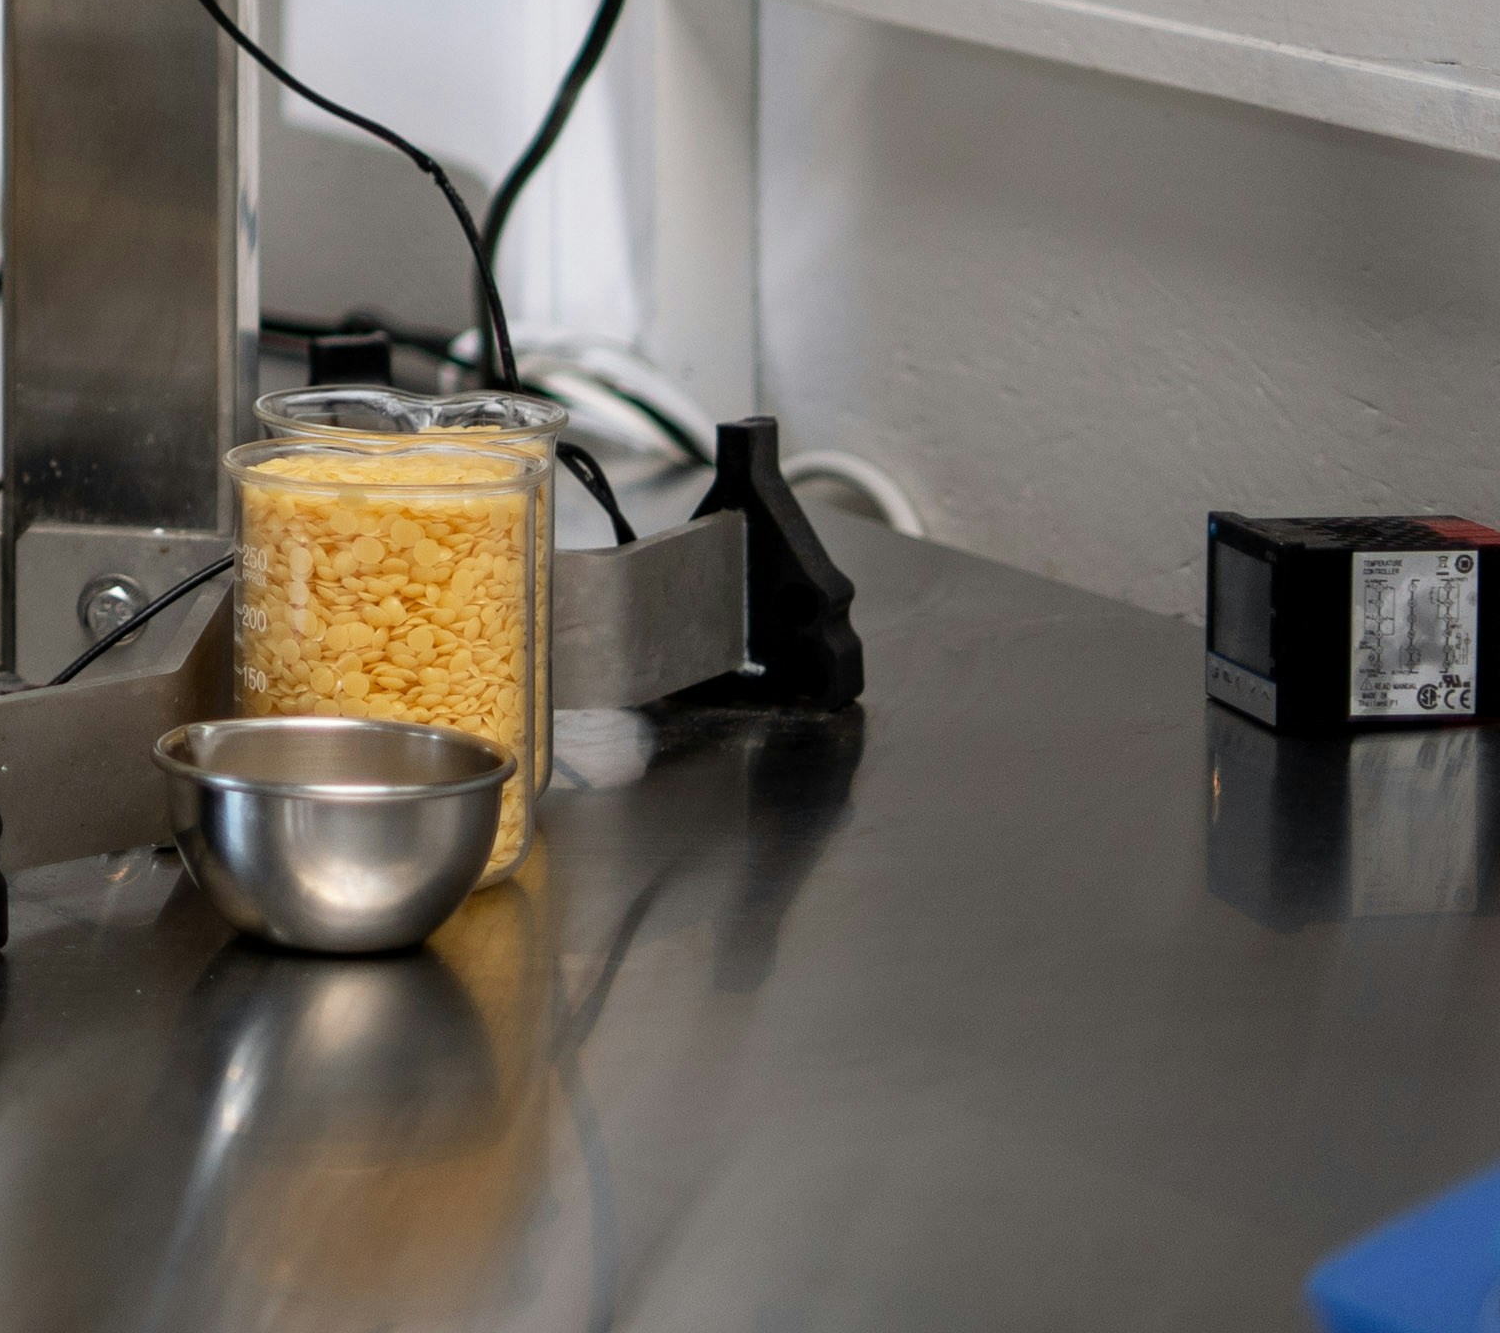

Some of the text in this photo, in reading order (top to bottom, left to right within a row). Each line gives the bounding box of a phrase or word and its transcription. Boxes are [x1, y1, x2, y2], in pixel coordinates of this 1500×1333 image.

[242, 544, 268, 572] 250
[1363, 559, 1403, 567] TEMPERATURE
[241, 604, 267, 632] 200
[242, 665, 267, 693] 150
